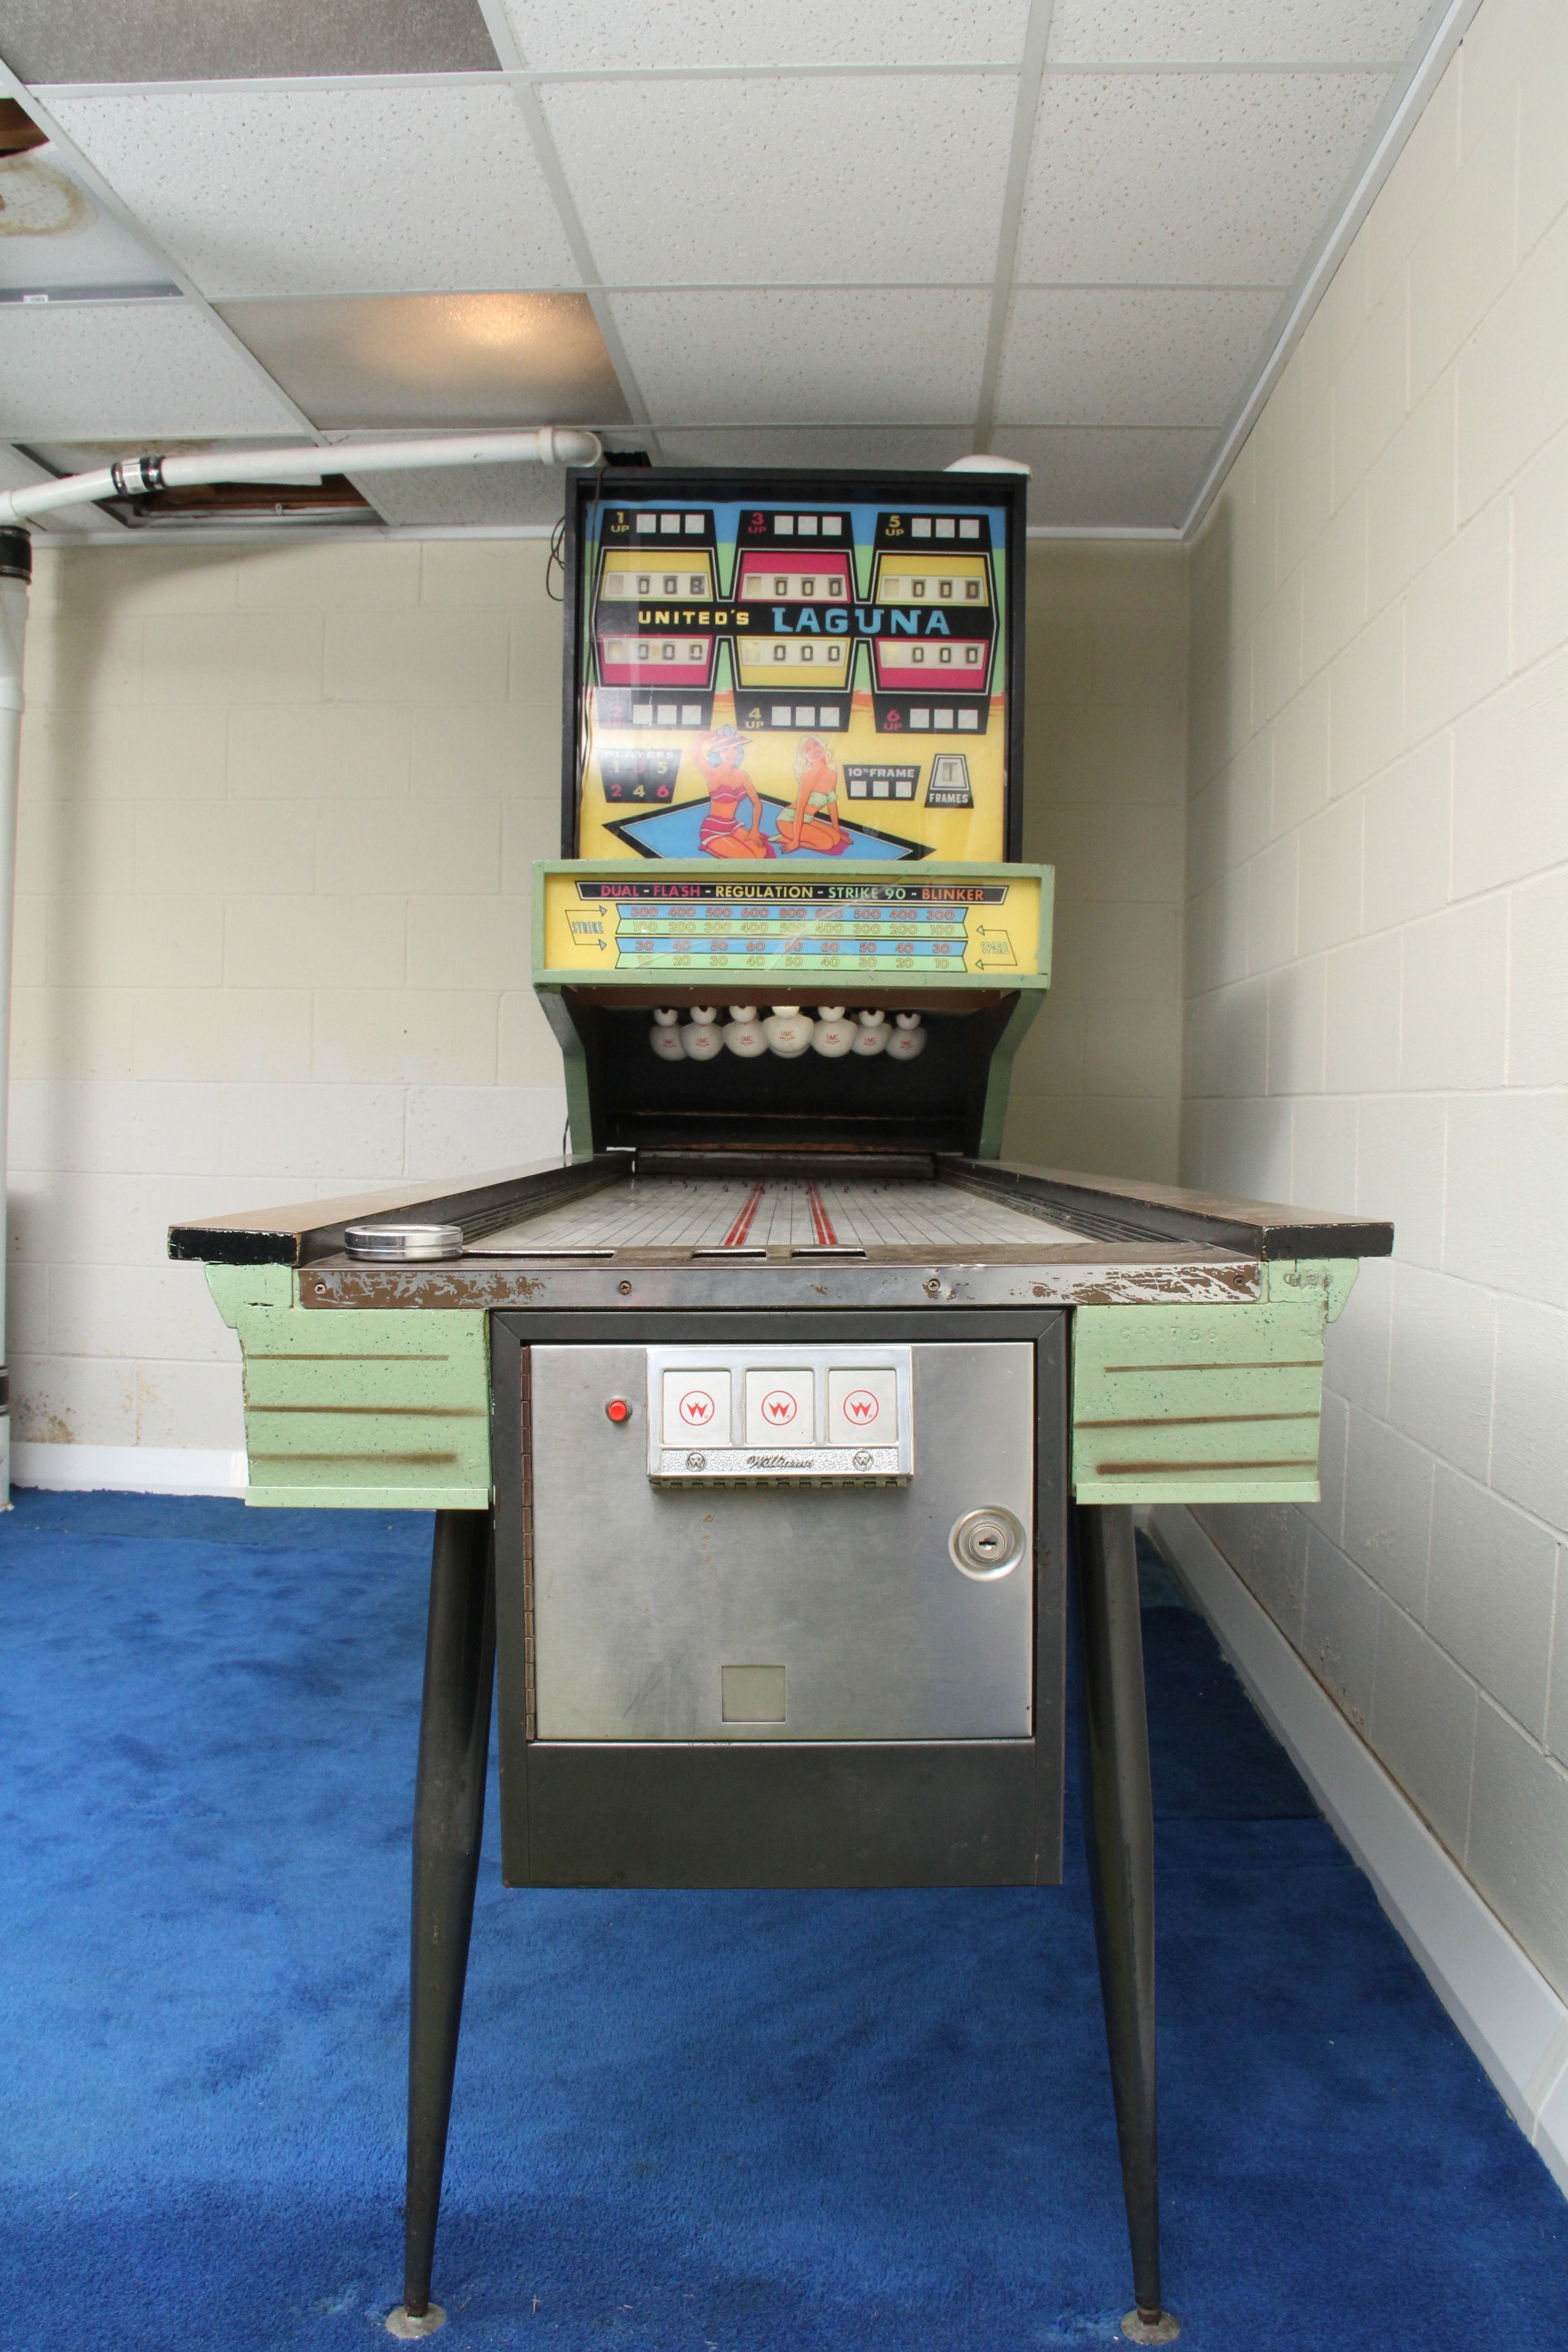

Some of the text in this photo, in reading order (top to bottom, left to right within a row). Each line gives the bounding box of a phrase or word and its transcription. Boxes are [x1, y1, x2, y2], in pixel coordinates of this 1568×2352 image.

[616, 512, 624, 524] 1
[751, 512, 764, 524] 3
[888, 515, 900, 528] 5
[611, 524, 630, 534] UP
[748, 525, 768, 534] UP
[638, 607, 951, 635] UNITED'S LAGUNA
[748, 707, 762, 720] 4
[887, 709, 900, 721] 6
[745, 720, 764, 729] UP
[884, 722, 903, 730] UP
[603, 750, 675, 760] PLAYERS
[657, 760, 668, 774] 5
[869, 769, 915, 778] FRAME
[610, 784, 670, 798] 2 4 6
[929, 793, 968, 804] FRAMES
[601, 885, 985, 901] DUAL FLASH REGULATION STRIKE 90 BLINKER
[631, 906, 659, 917] 300
[668, 906, 696, 917] 400
[705, 906, 732, 917] 500
[740, 906, 769, 917] 600
[779, 907, 807, 918] 800
[854, 908, 881, 919] 500
[889, 908, 917, 920] 400
[926, 909, 955, 920] 300
[572, 921, 604, 935] STRIKE
[632, 921, 658, 933] 100
[668, 921, 696, 933] 200
[704, 921, 732, 933] 300
[740, 922, 769, 933] 400
[853, 923, 880, 935] 300
[889, 924, 917, 935] 200
[930, 924, 955, 936] 100
[636, 939, 653, 951] 30
[672, 939, 691, 951] 40
[710, 939, 728, 951] 50
[746, 940, 765, 951] 60
[821, 941, 839, 952] 60
[859, 942, 877, 953] 50
[896, 942, 913, 953] 40
[933, 943, 950, 954] 30
[981, 941, 1009, 954] SPARE
[673, 956, 691, 966] 20
[710, 956, 728, 966] 30
[747, 956, 765, 966] 40
[785, 956, 803, 966] 50
[821, 956, 839, 966] 40
[896, 957, 913, 968] 20
[936, 957, 949, 968] 10
[747, 1455, 814, 1469] Williams
